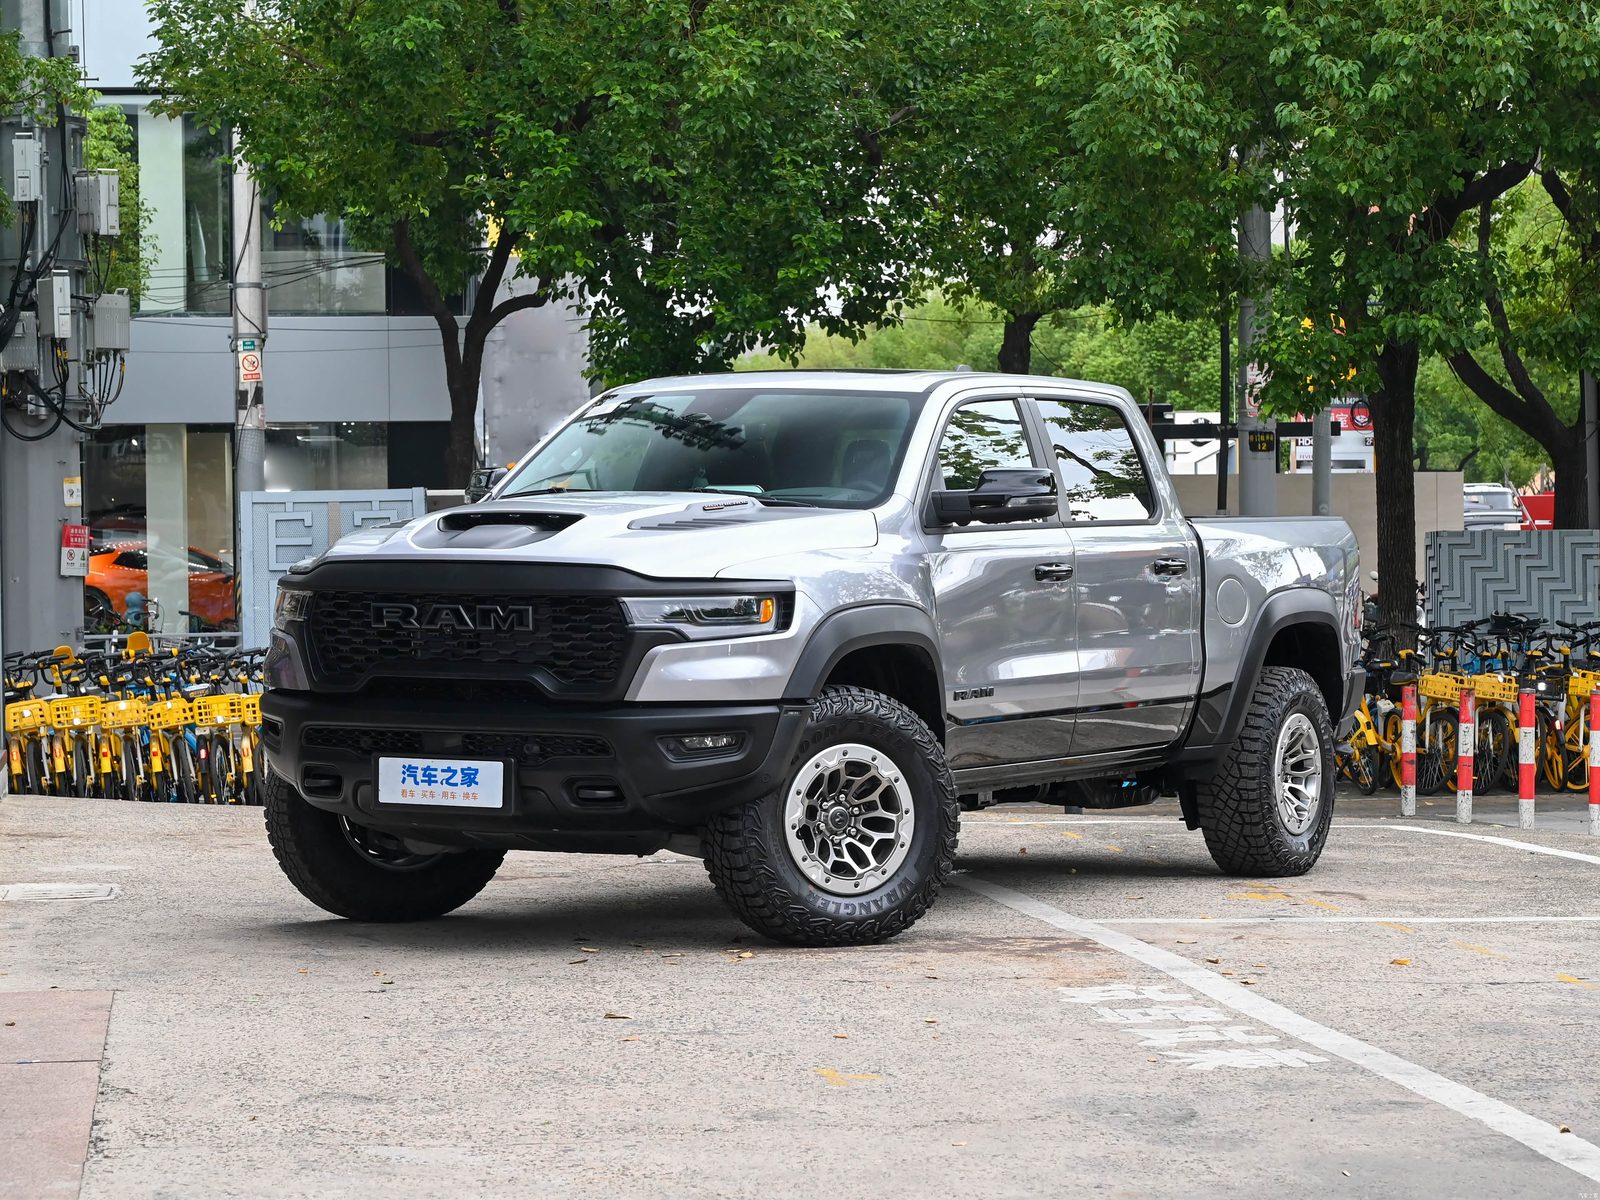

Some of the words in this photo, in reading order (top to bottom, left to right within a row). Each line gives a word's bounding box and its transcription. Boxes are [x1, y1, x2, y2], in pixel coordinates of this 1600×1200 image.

[371, 603, 533, 631] RAM
[953, 686, 995, 701] RAM
[401, 764, 480, 788] 汽车之家
[805, 877, 916, 917] WRANGLER
